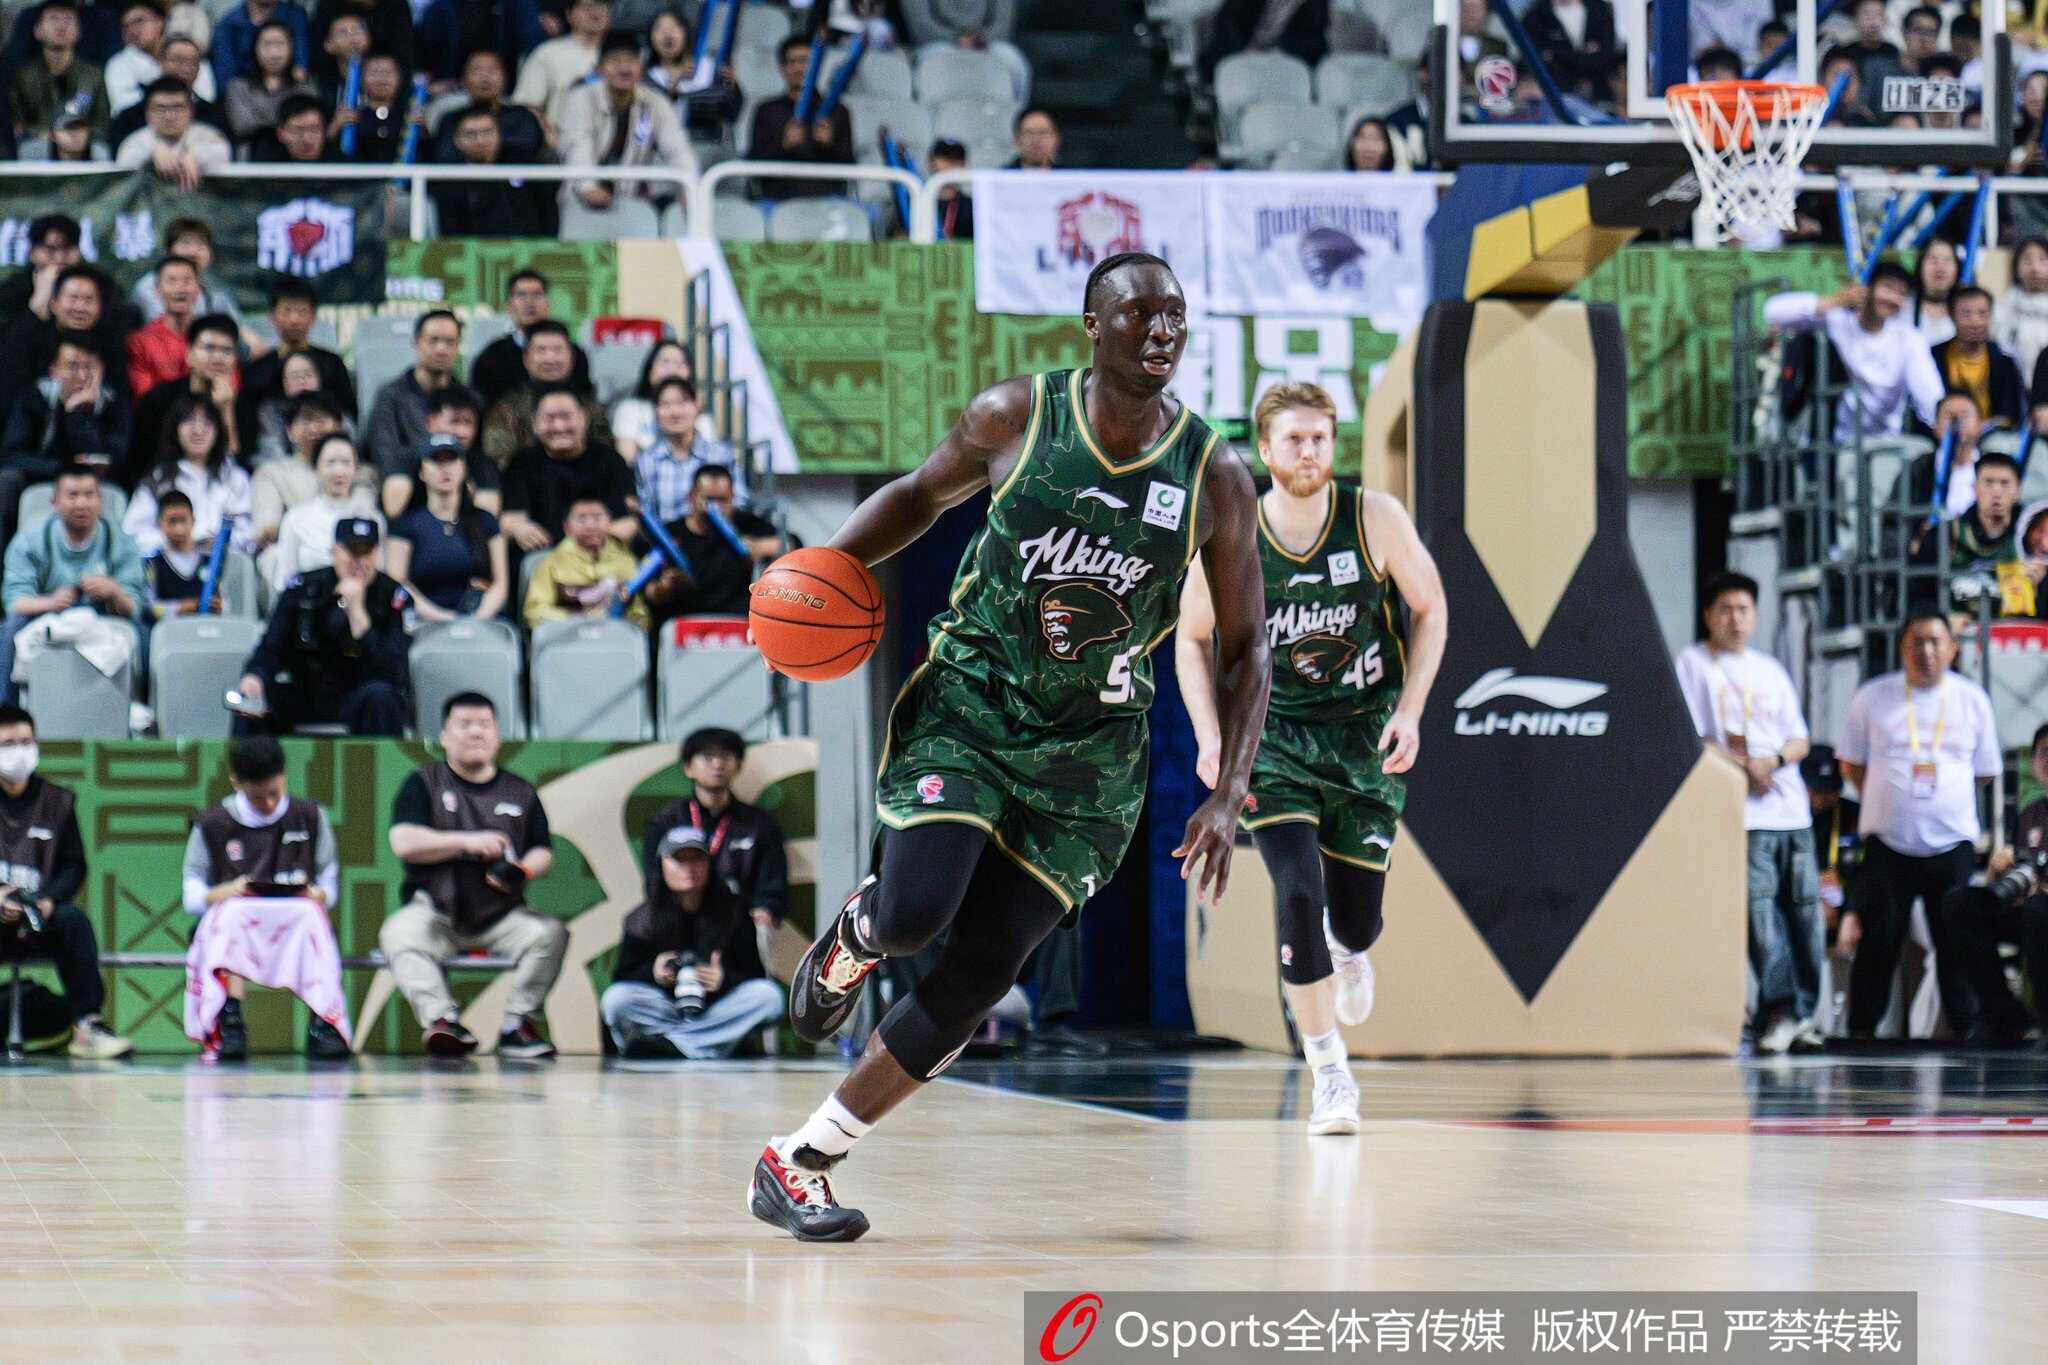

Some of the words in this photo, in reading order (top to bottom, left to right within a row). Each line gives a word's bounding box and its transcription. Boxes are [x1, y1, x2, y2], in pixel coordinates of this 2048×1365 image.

[1019, 526, 1153, 596] Mkings
[757, 586, 826, 610] LI-NING
[1266, 601, 1358, 648] Mkings
[1099, 644, 1144, 703] 5
[1341, 641, 1384, 690] 45
[1454, 711, 1609, 737] LI-NING
